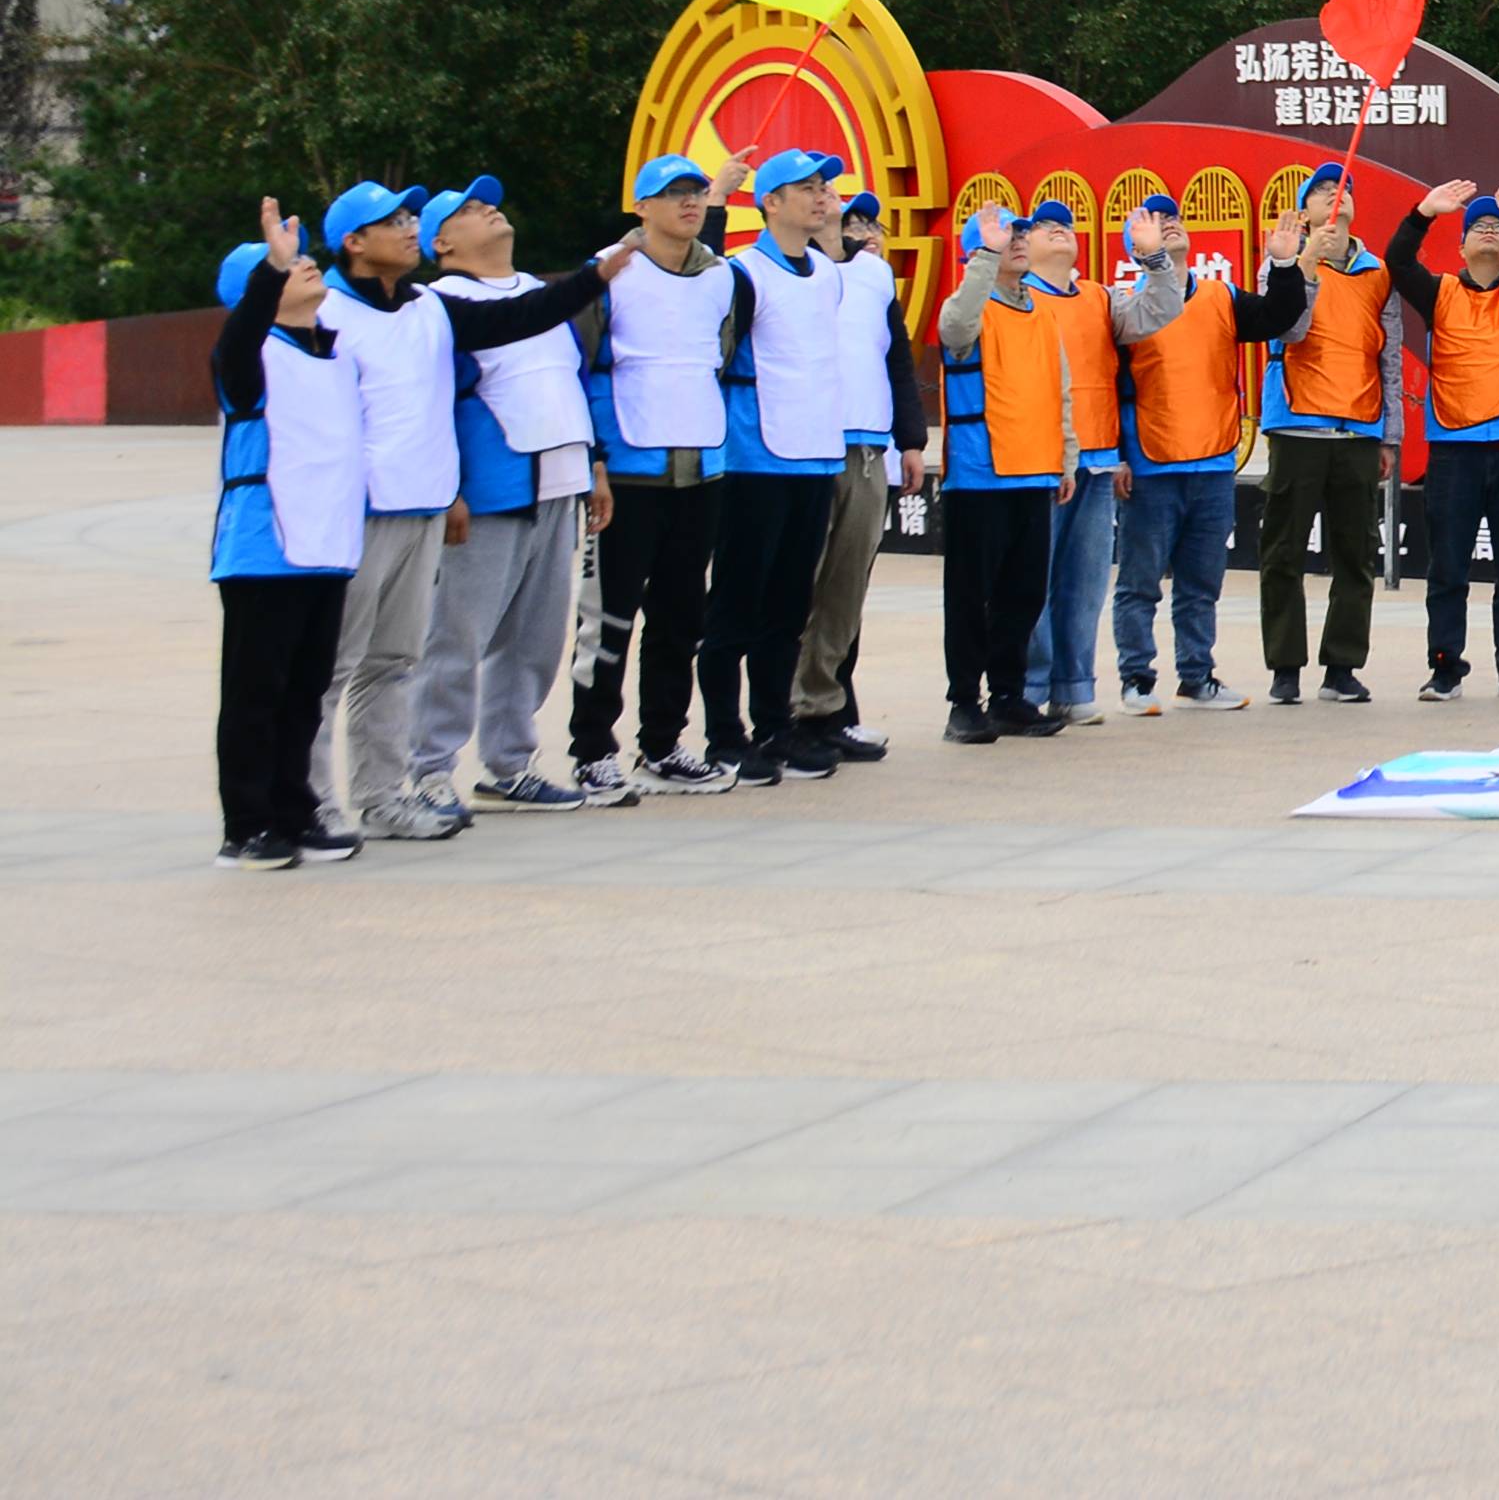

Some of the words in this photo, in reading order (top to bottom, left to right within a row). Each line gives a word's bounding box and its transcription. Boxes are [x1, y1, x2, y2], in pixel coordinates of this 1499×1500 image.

[1235, 41, 1406, 83] 弘扬宪法
[1274, 84, 1447, 126] 建设法治晋州
